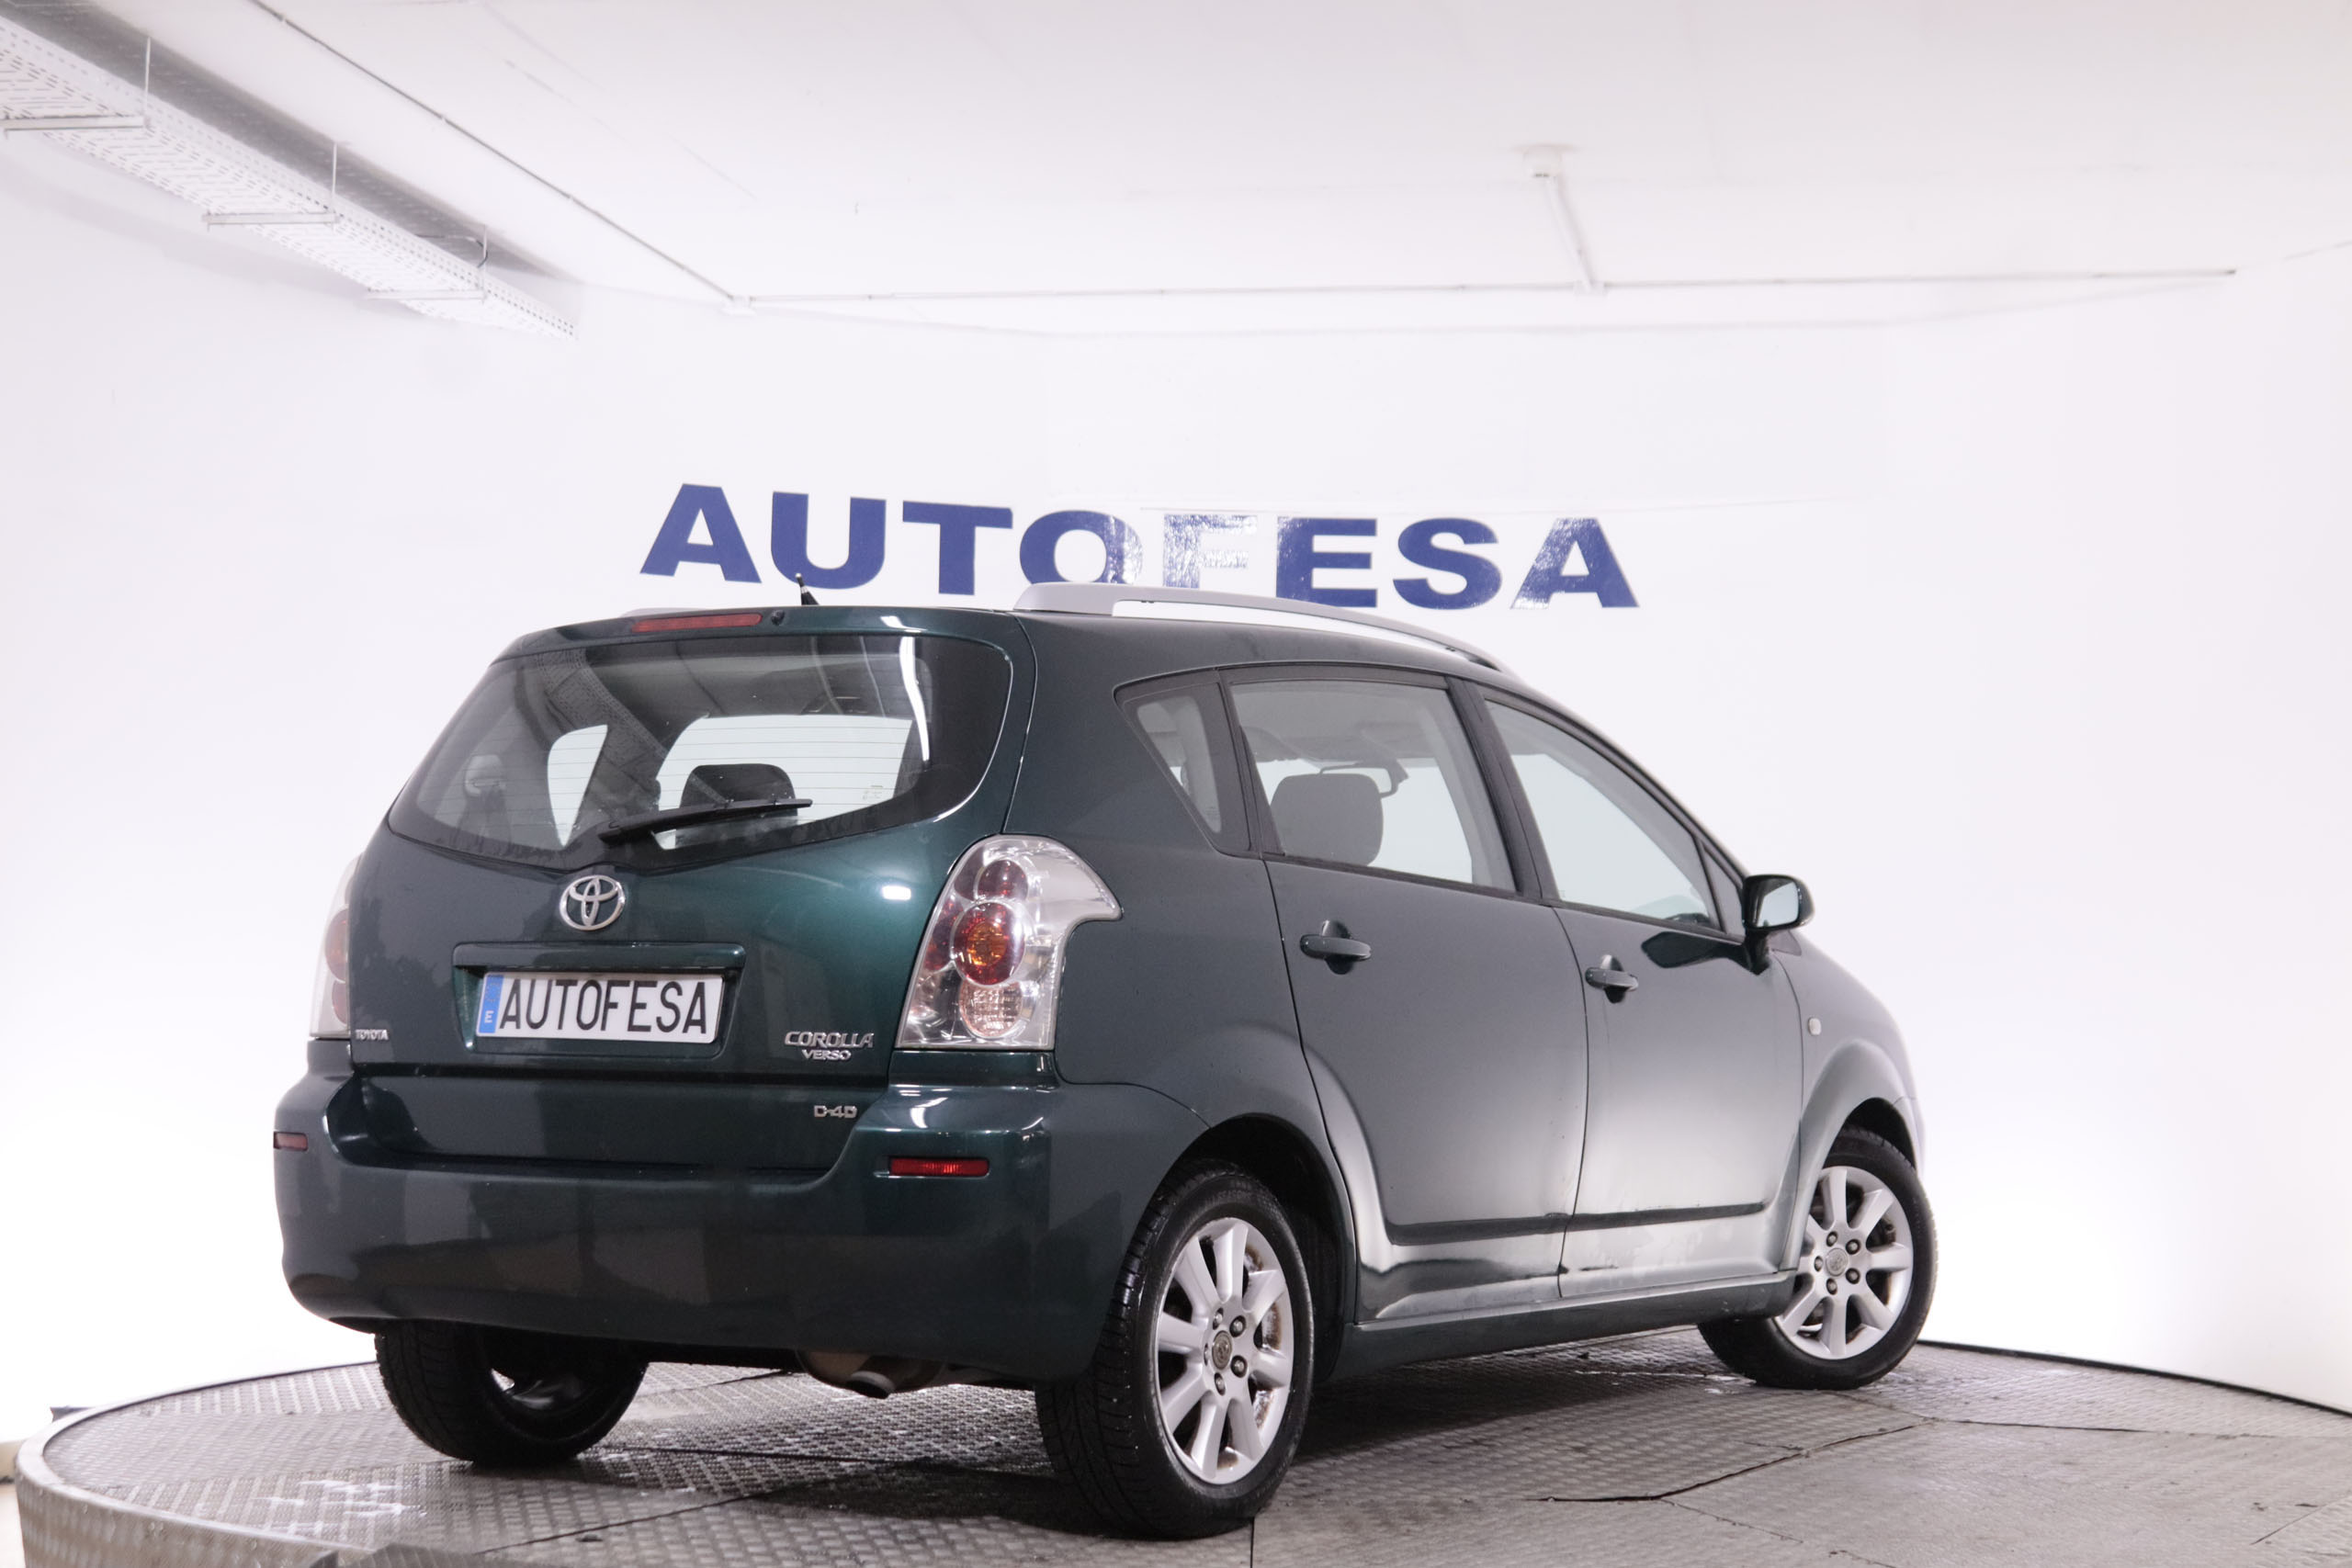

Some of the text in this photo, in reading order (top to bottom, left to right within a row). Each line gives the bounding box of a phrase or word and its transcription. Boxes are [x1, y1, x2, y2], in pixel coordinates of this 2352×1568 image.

[639, 483, 1640, 610] AUTOFESA
[499, 978, 707, 1034] AUTOFESA
[484, 1010, 494, 1023] E
[785, 1032, 875, 1048] COROLLA
[802, 1049, 852, 1060] VERSO
[814, 1105, 857, 1118] D-4D
